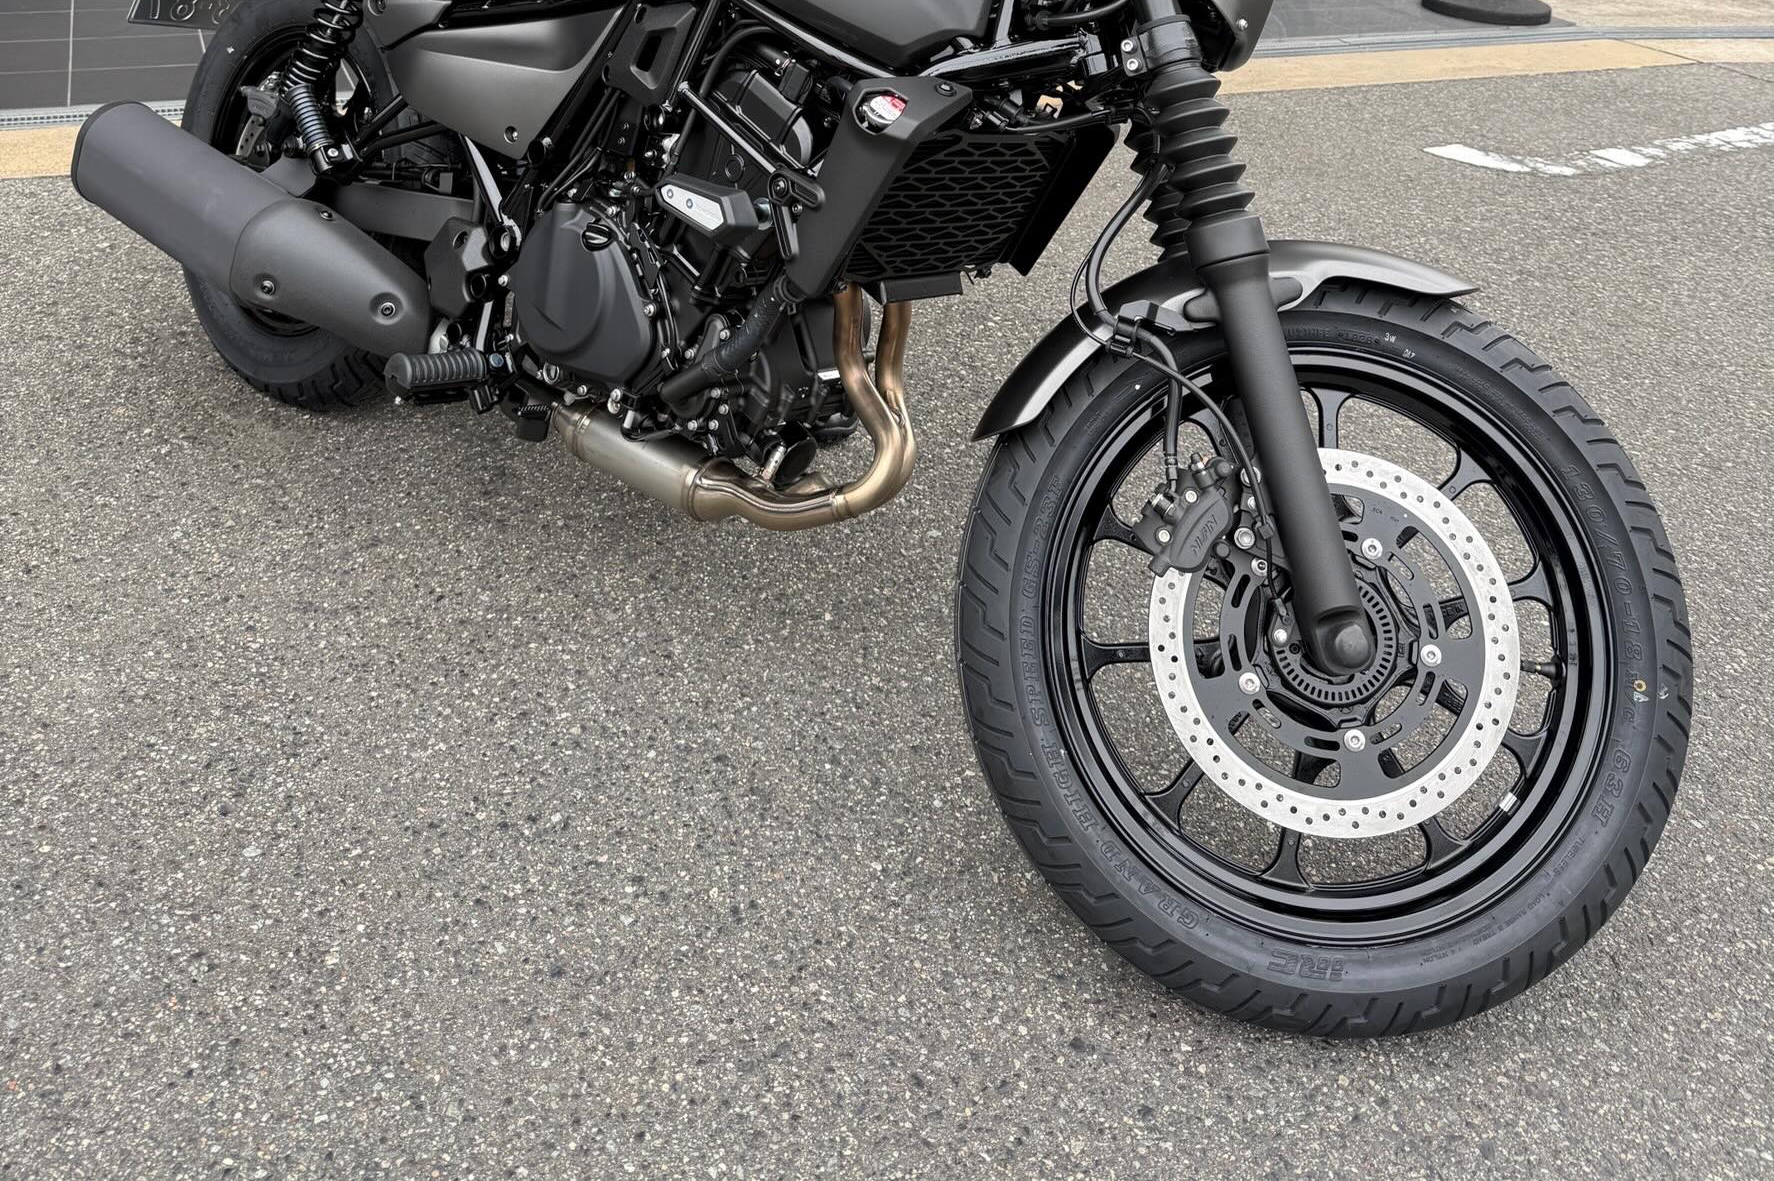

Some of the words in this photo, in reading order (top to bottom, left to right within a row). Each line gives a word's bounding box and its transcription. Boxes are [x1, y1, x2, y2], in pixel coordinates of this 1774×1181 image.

[1021, 475, 1065, 599] GS-23F
[1560, 464, 1643, 661] 130/70-18
[1019, 615, 1048, 727] SPEED
[1040, 736, 1097, 832] HIGH
[1591, 748, 1632, 828] 63H
[1099, 839, 1201, 930] GRAND
[1267, 947, 1345, 981] IRC
